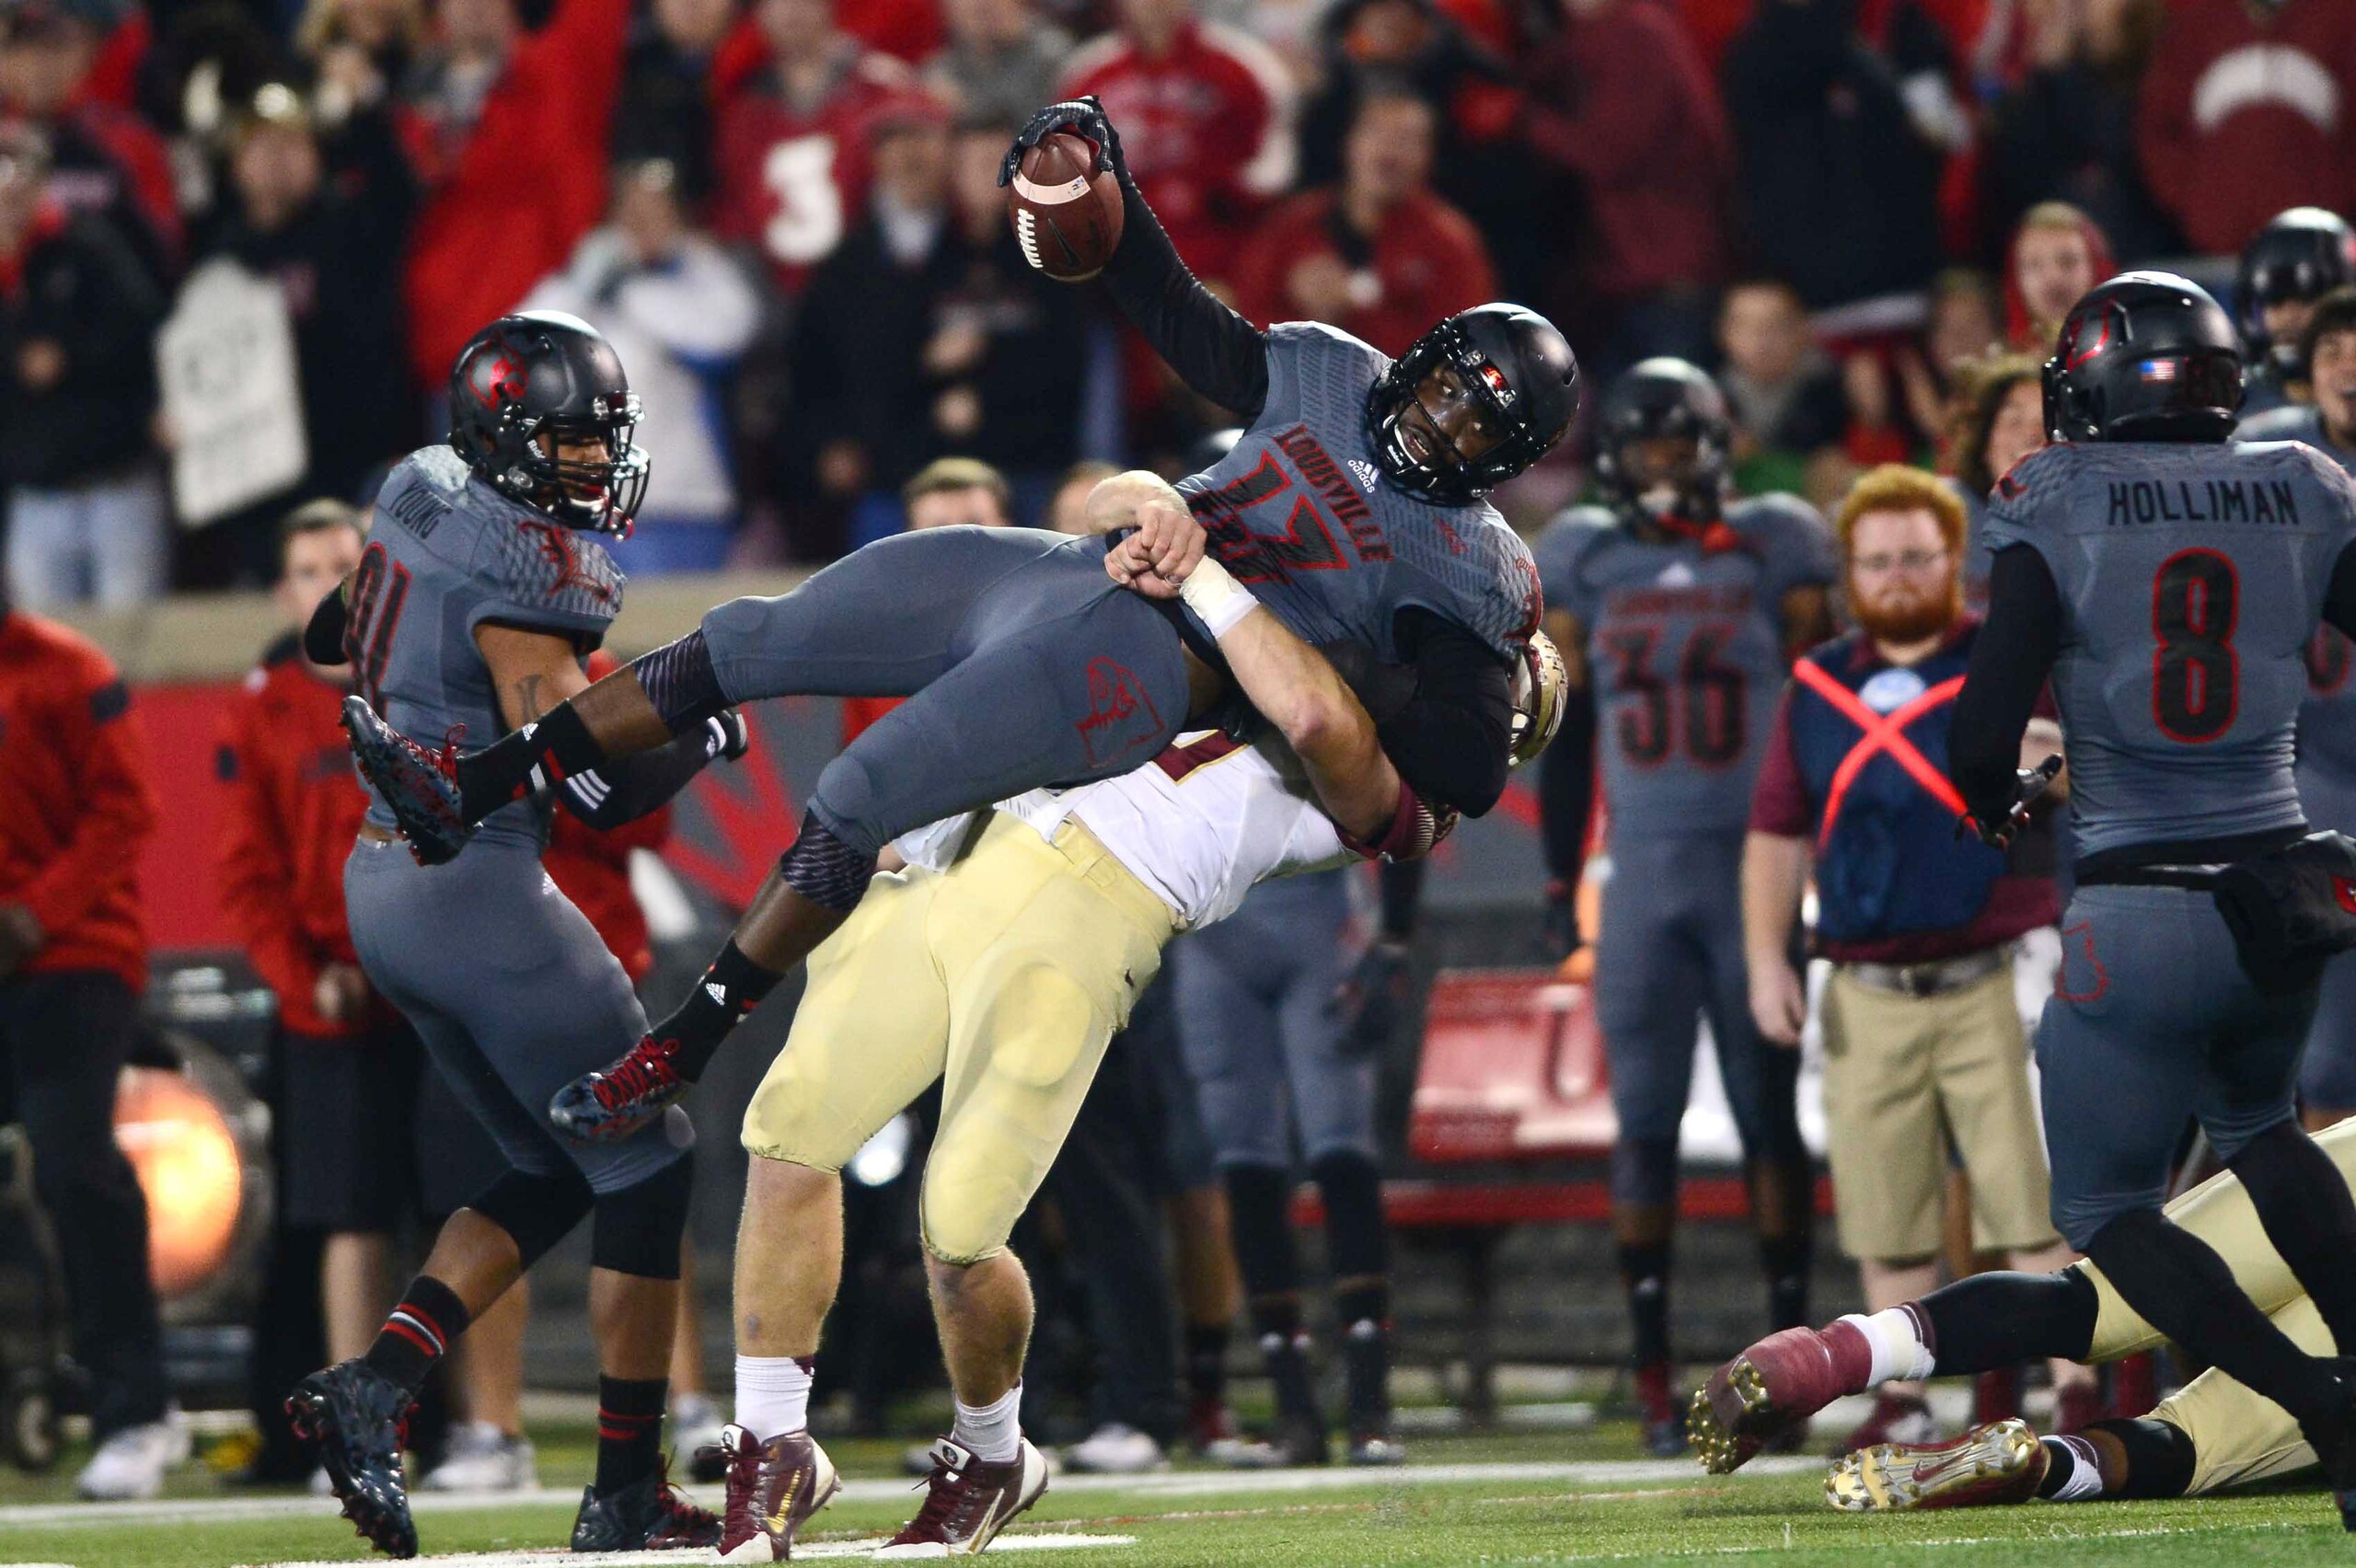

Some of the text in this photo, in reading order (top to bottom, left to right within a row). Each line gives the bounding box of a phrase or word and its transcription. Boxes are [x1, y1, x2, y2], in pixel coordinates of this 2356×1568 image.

[390, 480, 454, 539] YOUNG
[1272, 424, 1395, 562] LOUISVILLE
[1347, 460, 1376, 494] adidas
[2108, 479, 2299, 525] HOLLIMAN
[341, 541, 412, 722] 91
[1595, 622, 1750, 771] 36
[2151, 547, 2239, 745] 8
